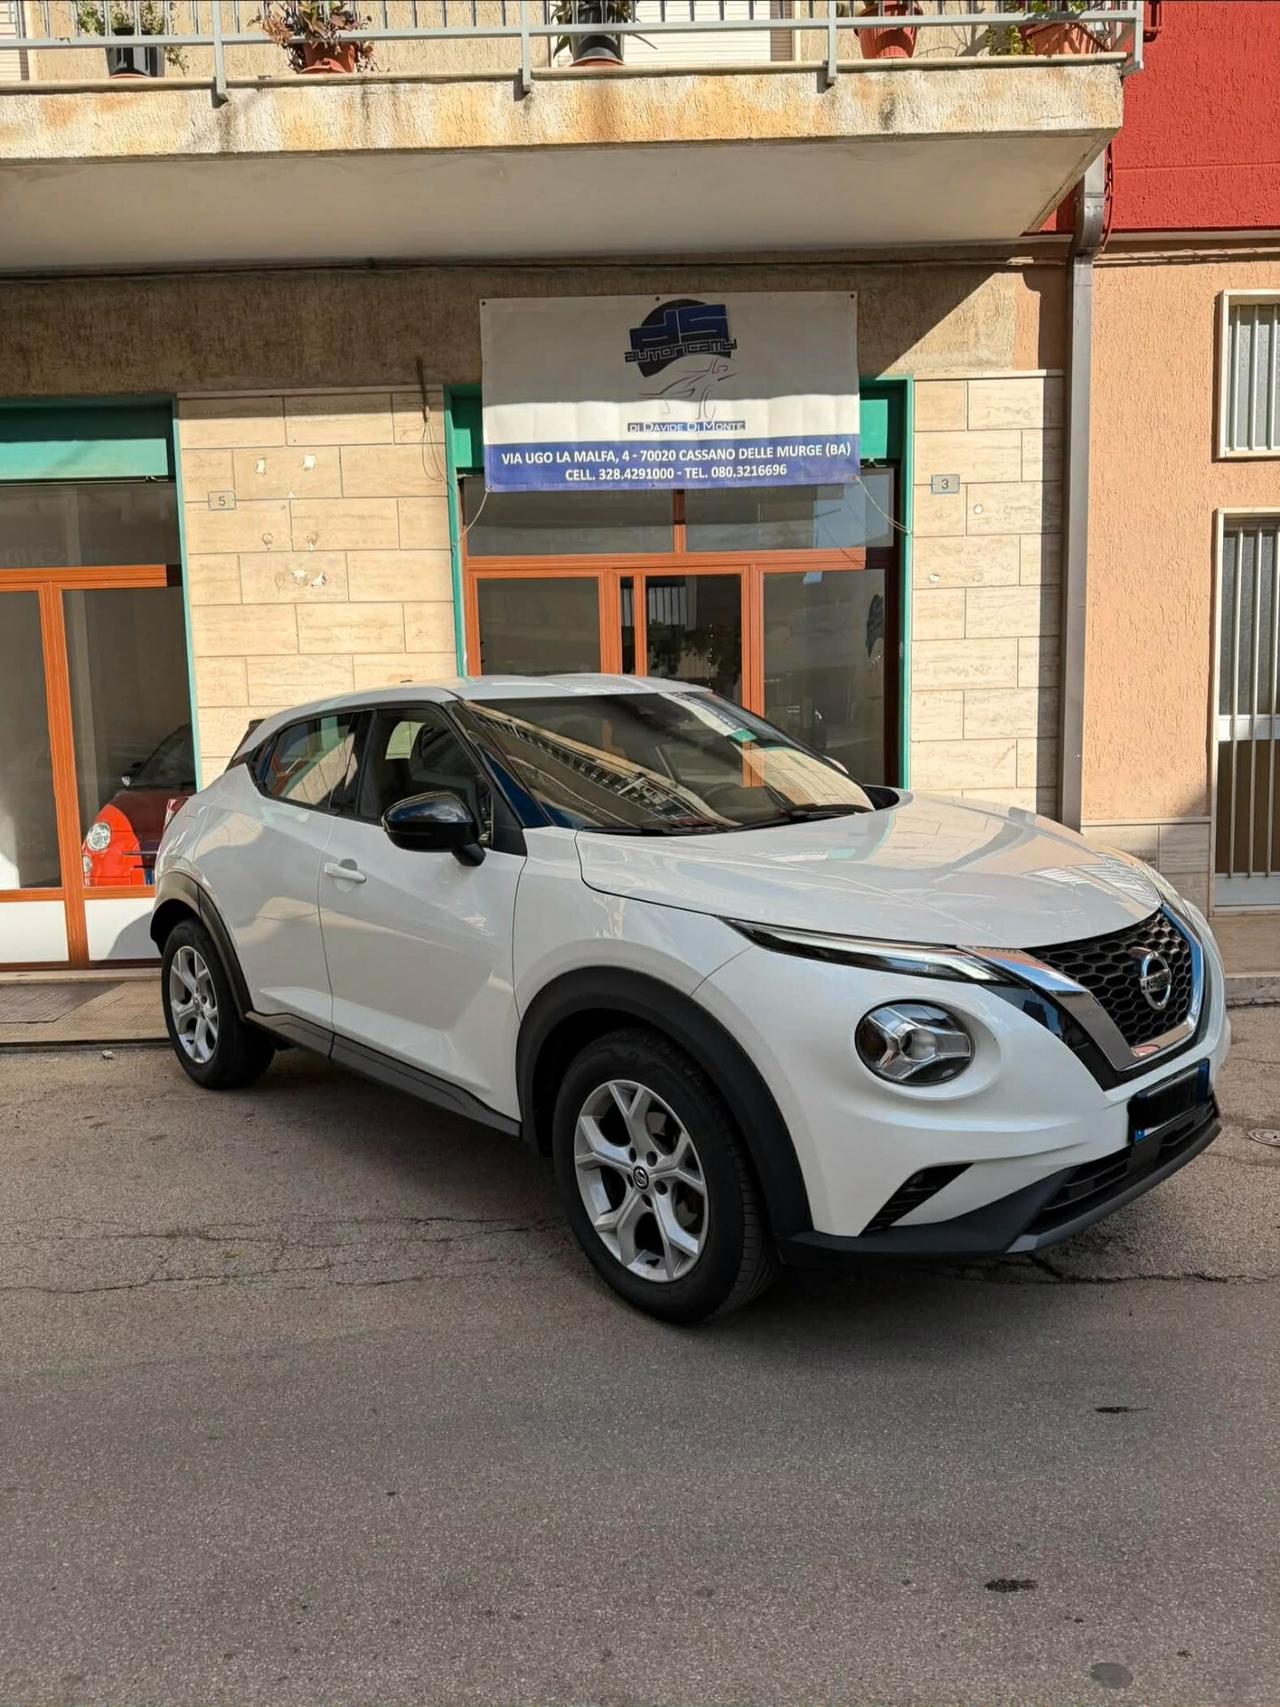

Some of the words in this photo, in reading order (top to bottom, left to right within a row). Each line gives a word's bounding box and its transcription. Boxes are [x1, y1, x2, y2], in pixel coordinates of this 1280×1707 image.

[501, 453, 523, 464] VIA
[526, 452, 553, 464] UGO
[556, 451, 571, 463] LA
[574, 450, 619, 464] MALFA,
[622, 450, 630, 461] 4
[640, 450, 676, 462] 70020
[679, 448, 736, 461] CASSANO
[739, 447, 773, 459] DELLE
[777, 444, 822, 457] MURGE
[825, 442, 851, 457] (BA)
[565, 469, 595, 481] CELL.
[599, 467, 674, 481] 328.4291000
[684, 467, 708, 479] TEL.
[711, 464, 787, 478] 080.3216696
[941, 478, 950, 490] 3
[218, 495, 226, 507] 5
